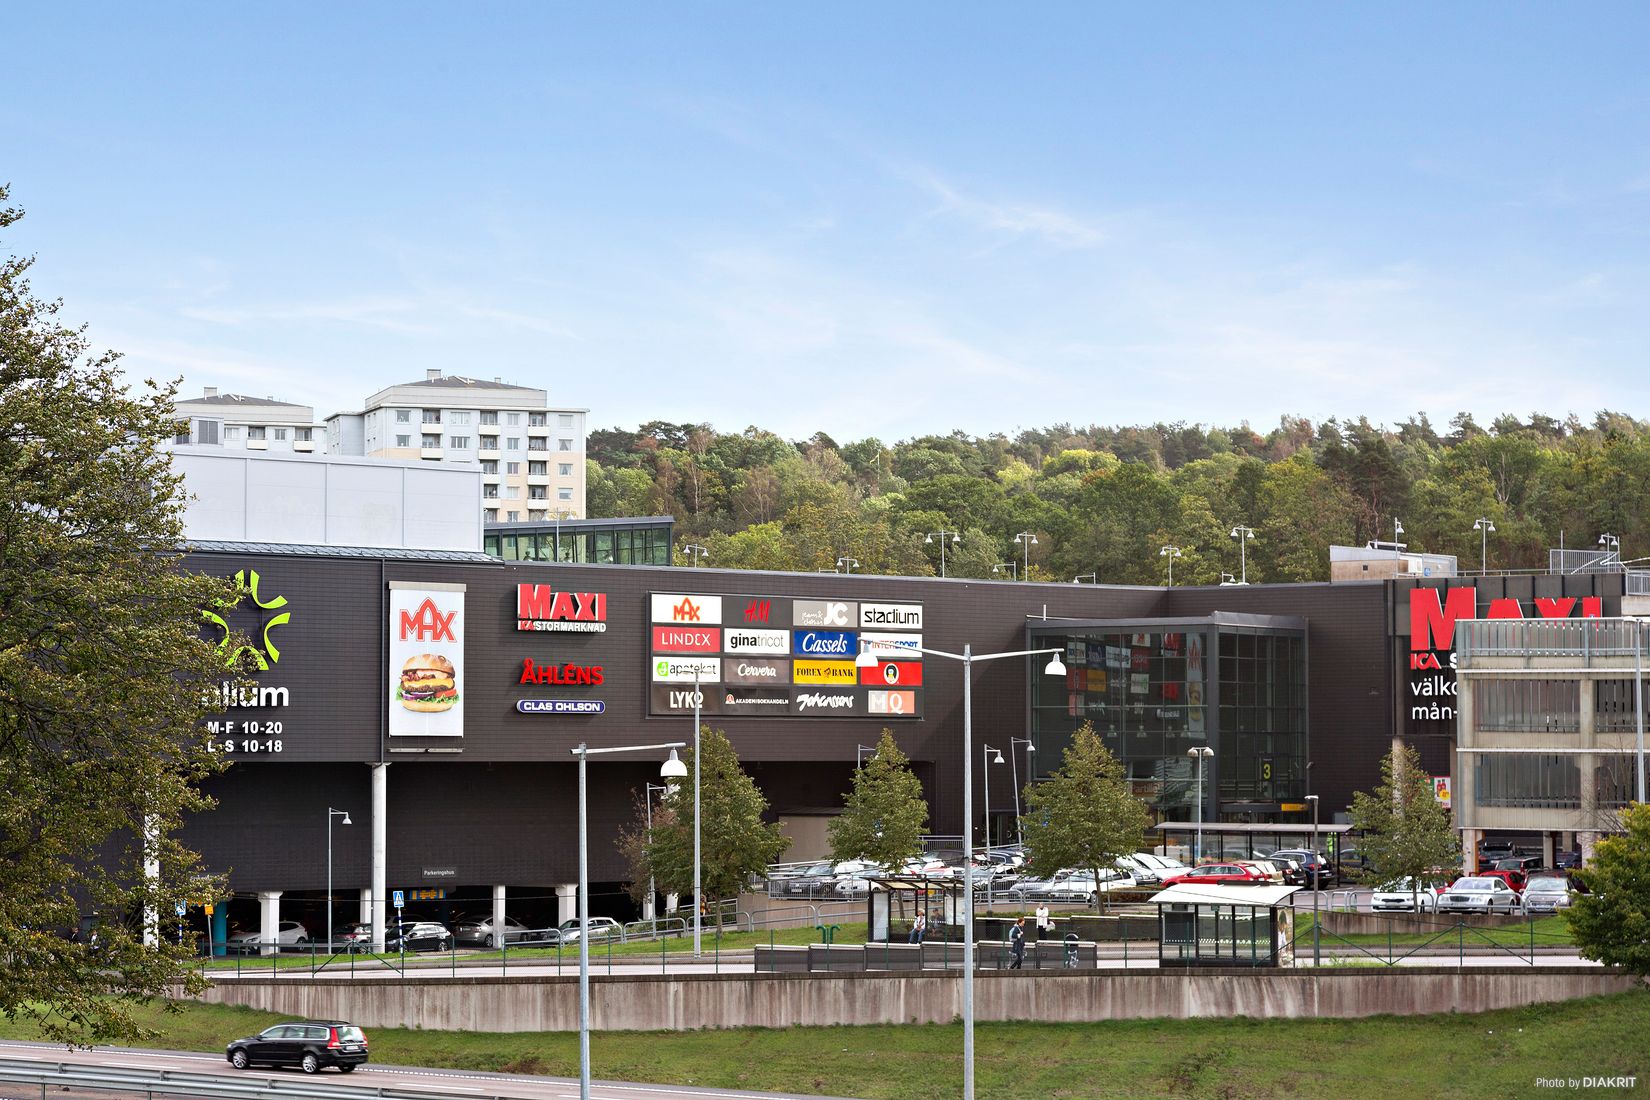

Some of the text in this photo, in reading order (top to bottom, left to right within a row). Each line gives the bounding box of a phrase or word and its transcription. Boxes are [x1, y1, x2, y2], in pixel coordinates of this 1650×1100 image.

[518, 584, 607, 621] MAXI
[673, 597, 701, 622] MAX
[399, 596, 458, 643] MAX
[823, 602, 849, 626] JC
[864, 608, 920, 625] stadium
[661, 632, 711, 646] LINDEX
[802, 633, 848, 653] Cassels
[737, 663, 777, 677] Cervera
[1410, 652, 1442, 670] ICA
[519, 657, 605, 686] ÅHLÉNS
[796, 667, 854, 677] FOREX BANK
[201, 680, 290, 707] llum
[523, 701, 601, 713] CLAS OHLSON
[871, 693, 904, 715] MQ
[207, 721, 283, 734] M-F 10-20
[242, 739, 283, 752] 10-18
[1263, 763, 1271, 779] 3
